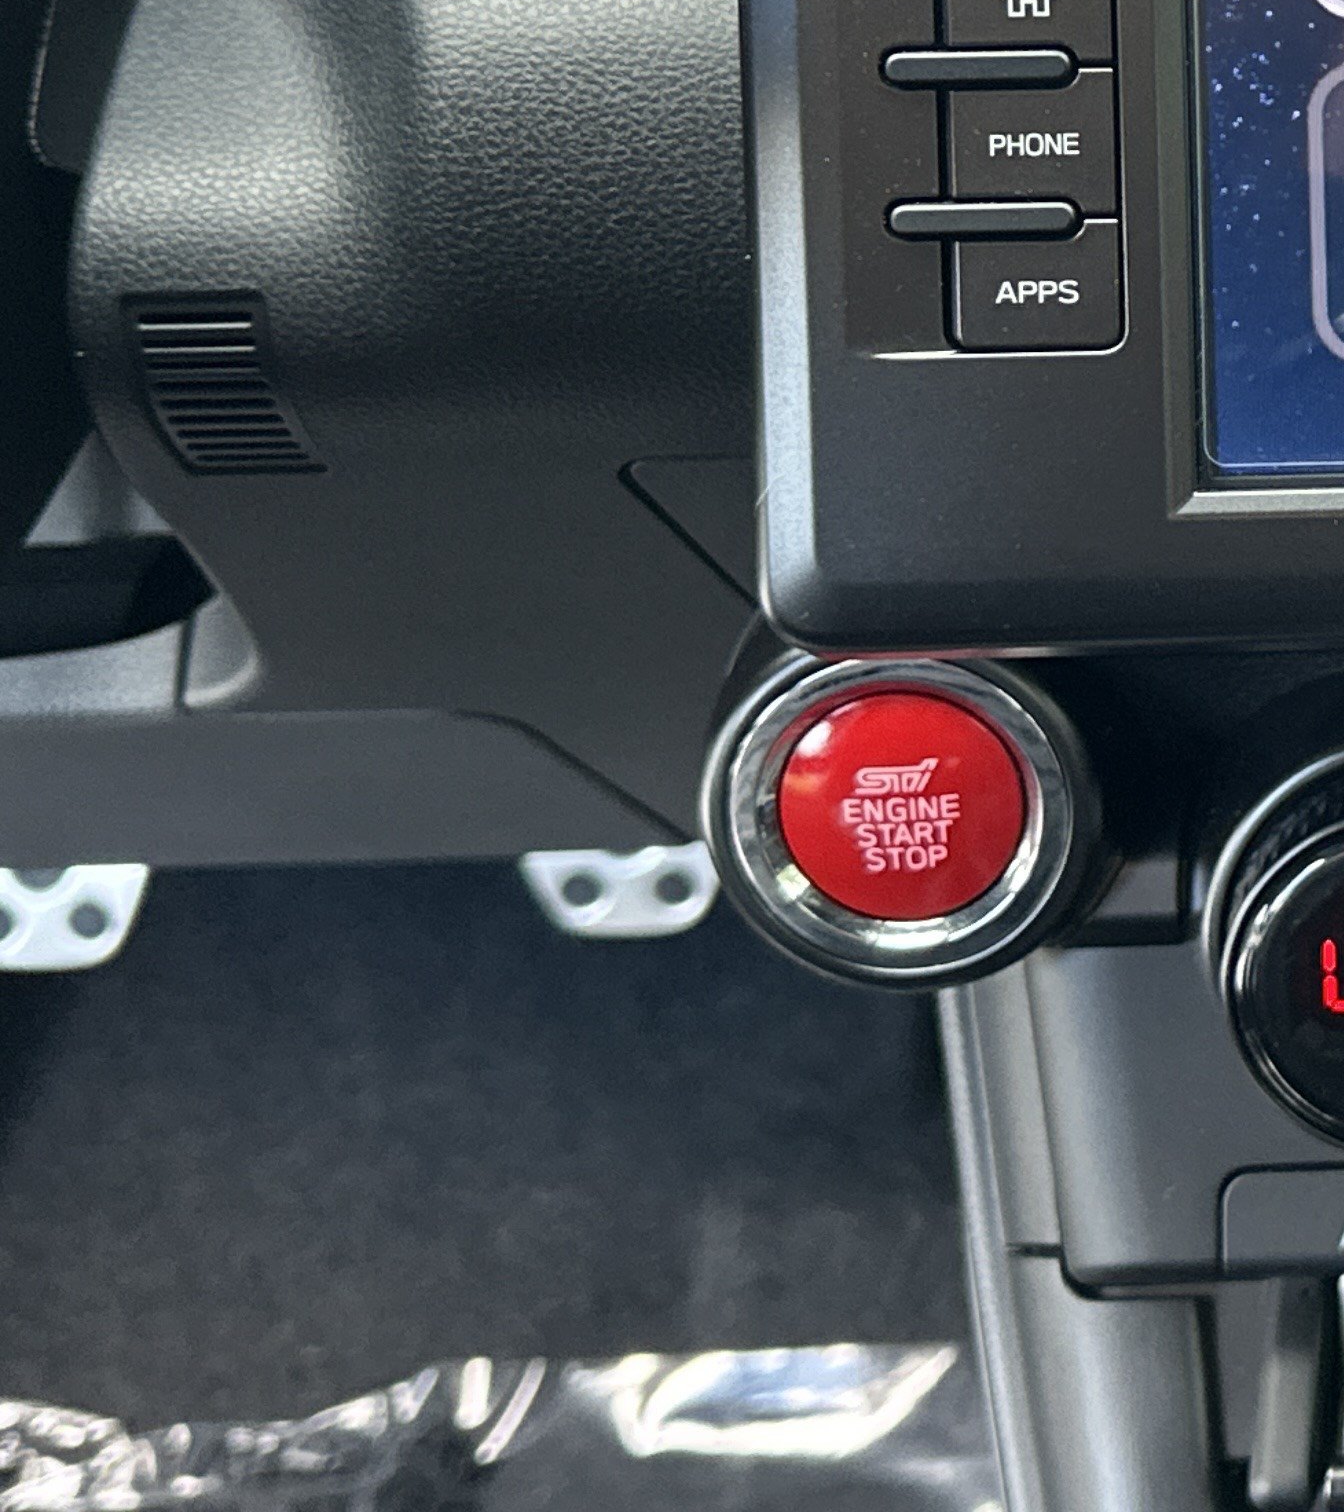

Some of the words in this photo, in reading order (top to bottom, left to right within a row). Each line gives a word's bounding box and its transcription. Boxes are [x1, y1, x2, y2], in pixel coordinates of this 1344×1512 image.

[989, 132, 1080, 157] PHONE
[995, 279, 1080, 304] APPS
[841, 793, 961, 823] ENGINE
[856, 819, 954, 848] START
[865, 844, 948, 872] STOP
